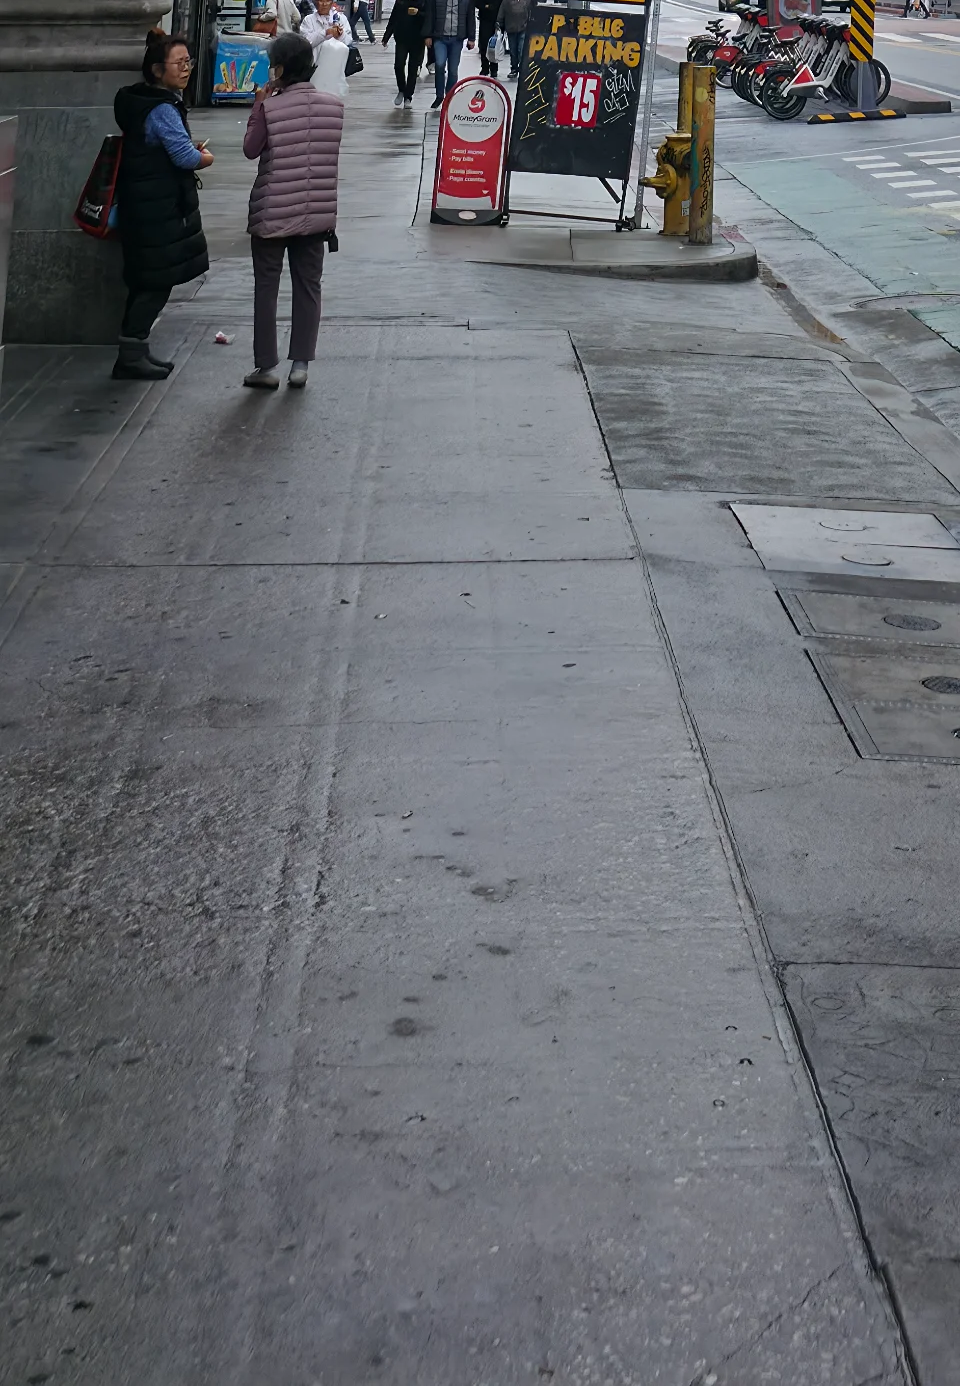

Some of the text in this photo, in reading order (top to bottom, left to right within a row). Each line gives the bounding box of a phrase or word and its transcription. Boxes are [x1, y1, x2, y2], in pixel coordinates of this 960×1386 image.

[551, 14, 625, 38] PBLIC
[529, 35, 641, 67] PARKING
[563, 76, 598, 123] $15
[453, 114, 498, 123] MoneyGram
